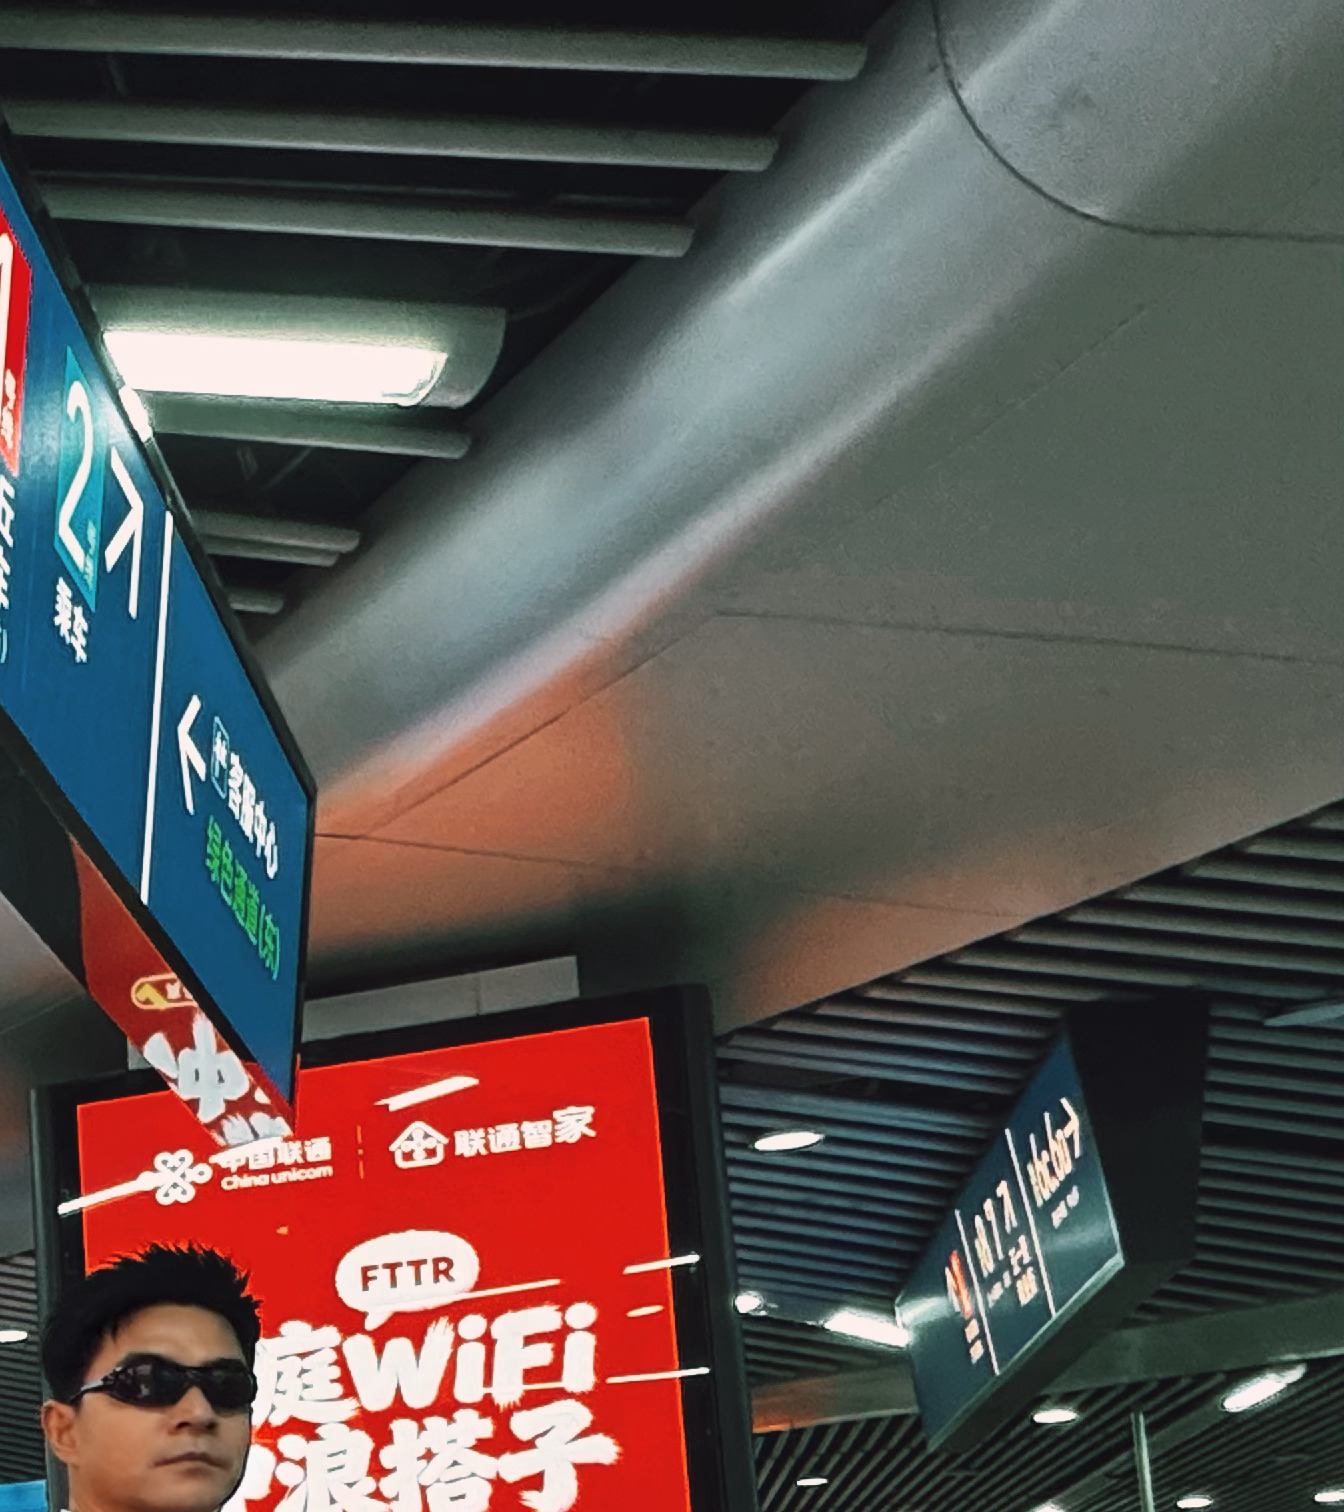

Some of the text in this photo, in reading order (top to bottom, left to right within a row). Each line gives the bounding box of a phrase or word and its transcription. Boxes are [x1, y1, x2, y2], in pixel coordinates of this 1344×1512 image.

[54, 576, 88, 663] 乘车
[454, 1106, 597, 1157] 联通智家
[271, 1165, 333, 1185] unicom
[360, 1255, 456, 1292] FTTR
